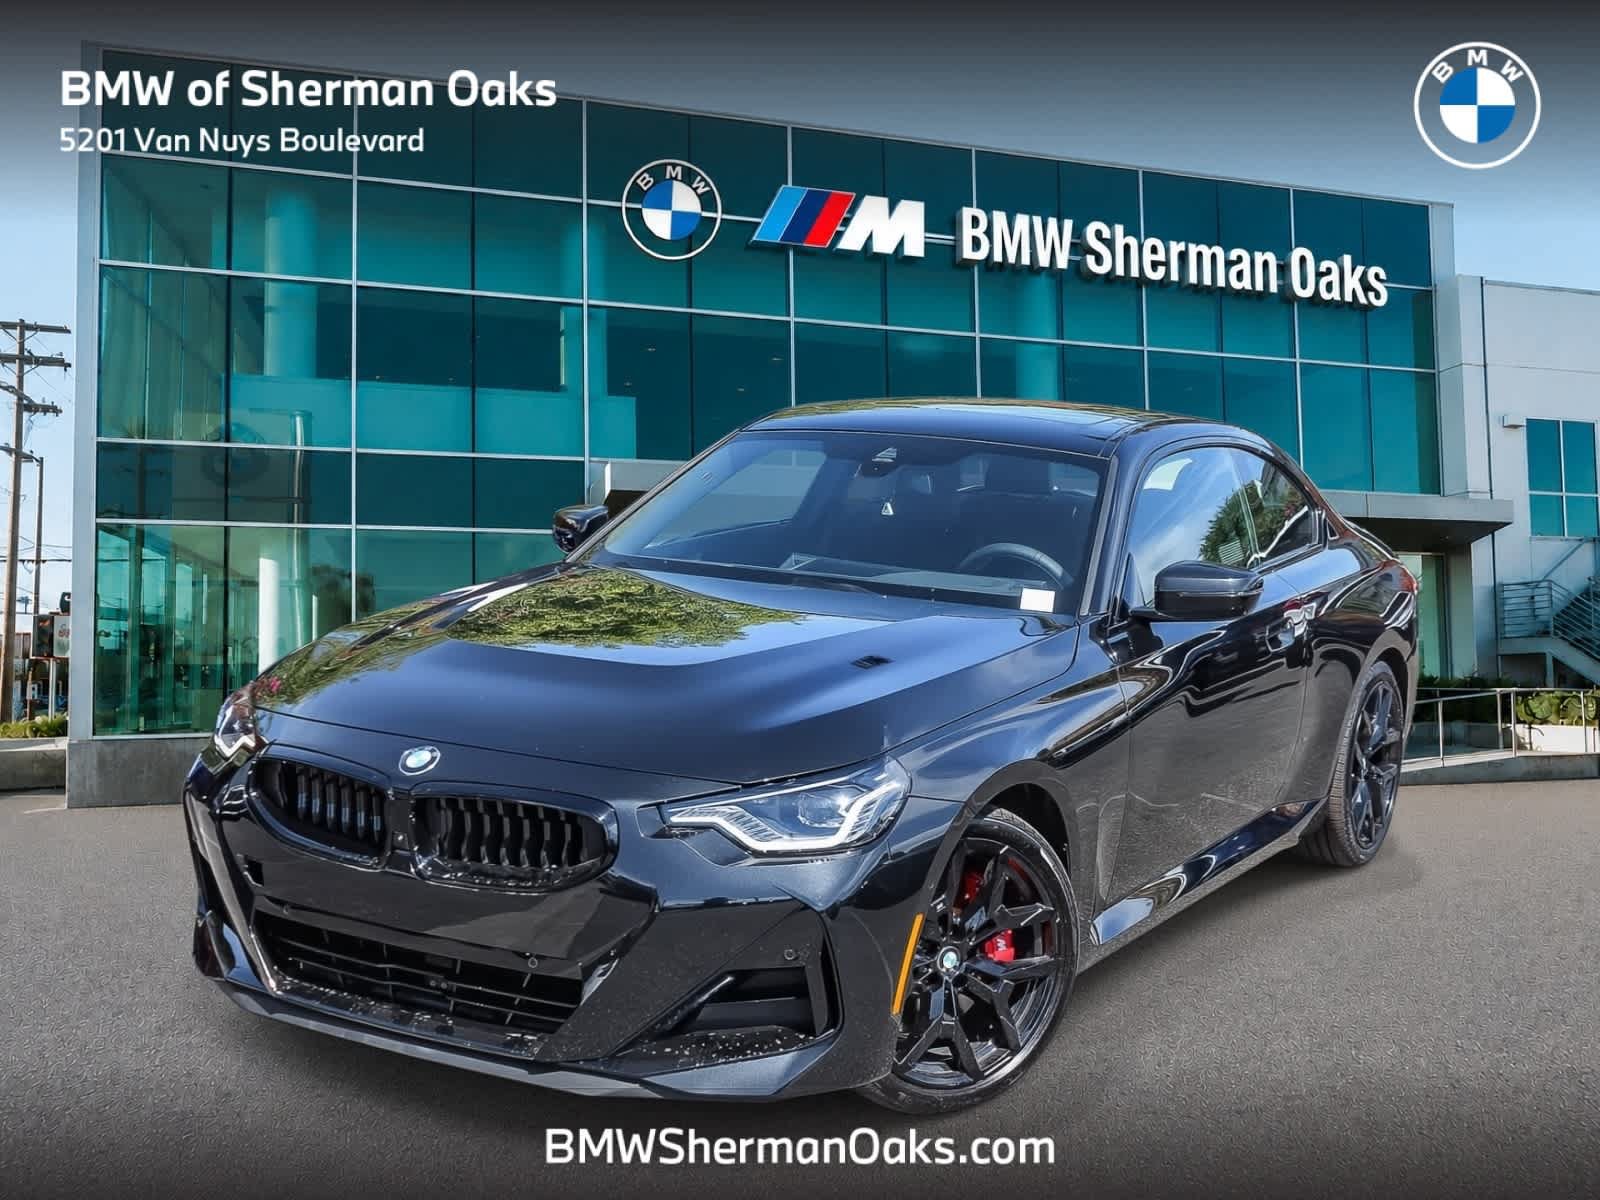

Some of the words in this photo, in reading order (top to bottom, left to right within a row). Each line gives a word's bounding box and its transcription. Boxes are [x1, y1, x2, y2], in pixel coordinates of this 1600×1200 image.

[636, 165, 711, 195] BMW
[836, 194, 925, 257] M
[960, 206, 1073, 270] BMW
[1083, 220, 1278, 294] Sherman
[1289, 246, 1389, 308] Oaks
